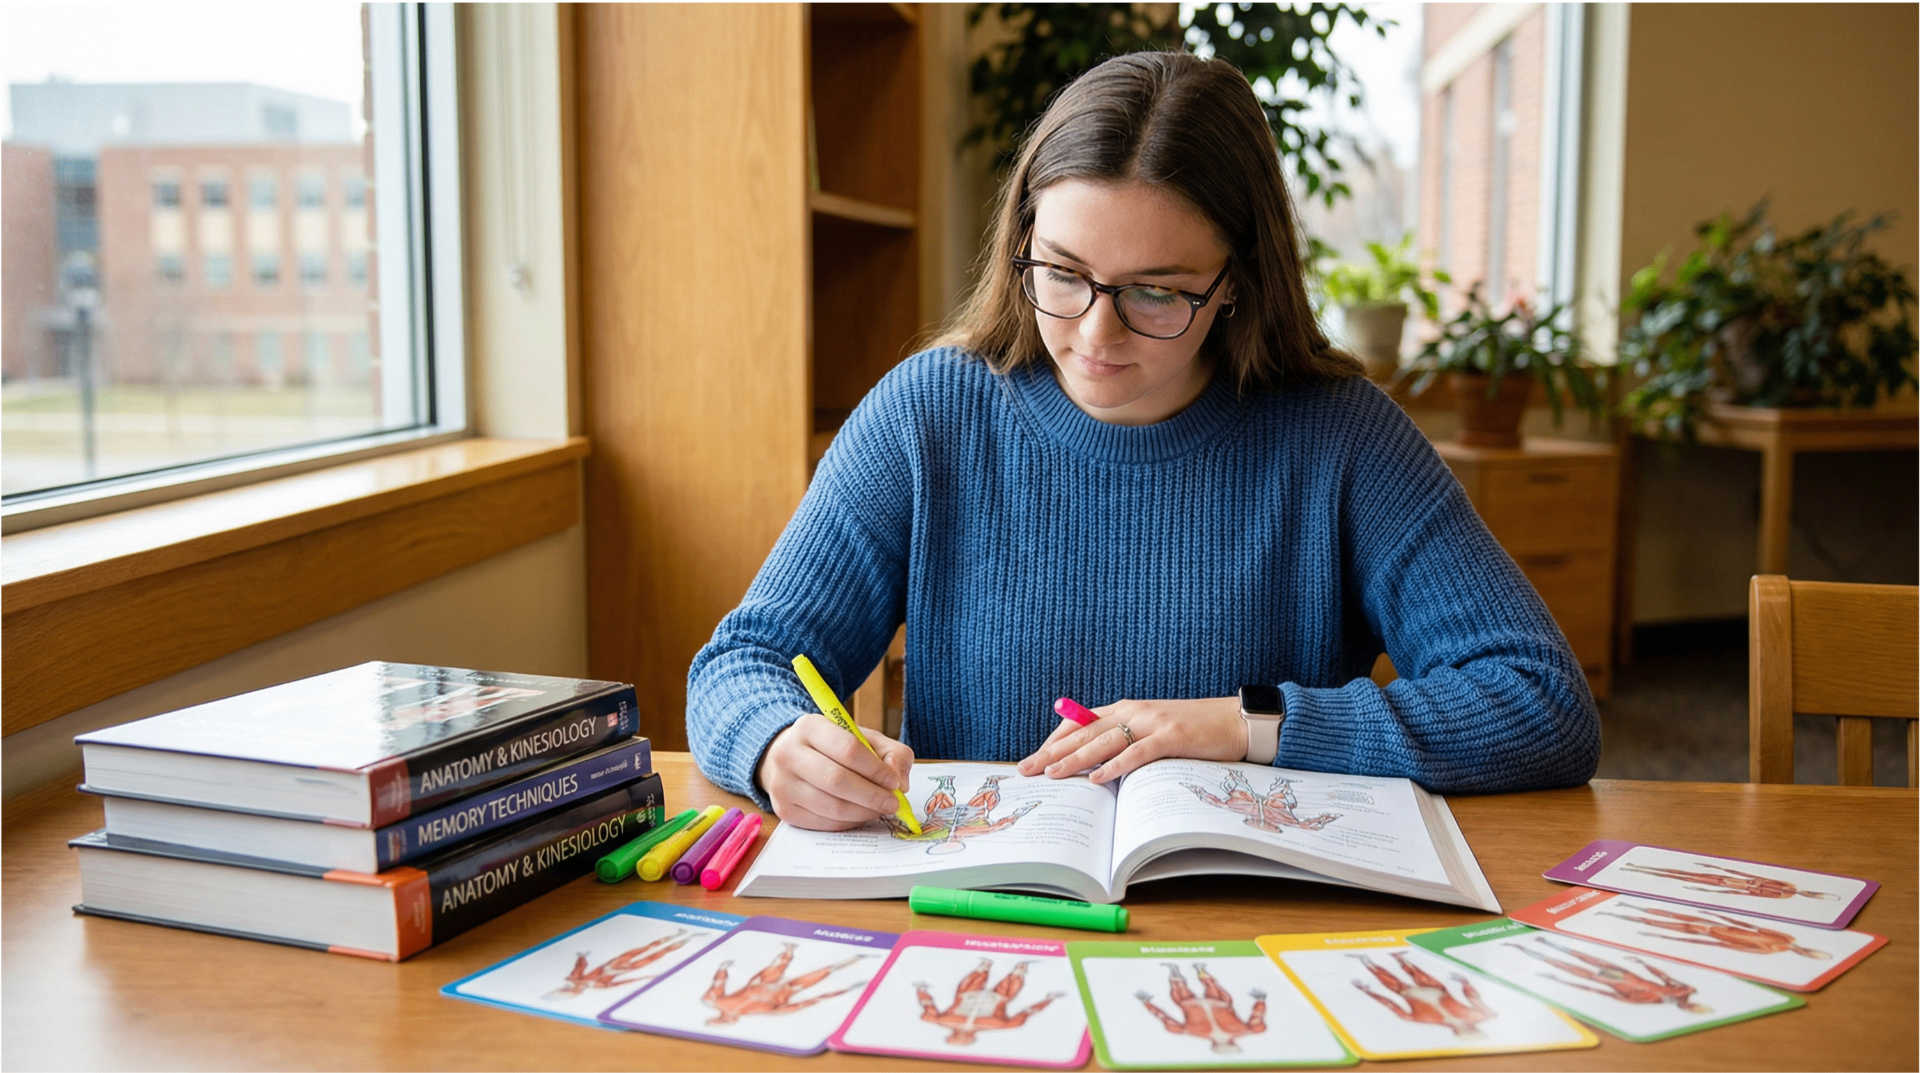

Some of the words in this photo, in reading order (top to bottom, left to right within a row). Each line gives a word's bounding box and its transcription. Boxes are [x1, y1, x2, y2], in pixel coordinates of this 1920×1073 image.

[420, 752, 494, 794] ANATOMY
[497, 746, 509, 768] &
[510, 716, 598, 760] KINESIOLOGY
[418, 805, 488, 847] MEMORY
[489, 773, 579, 821] TECHNIQUES
[441, 860, 519, 914] ANATOMY
[522, 855, 535, 878] &
[537, 813, 627, 872] KINESIOLOGY
